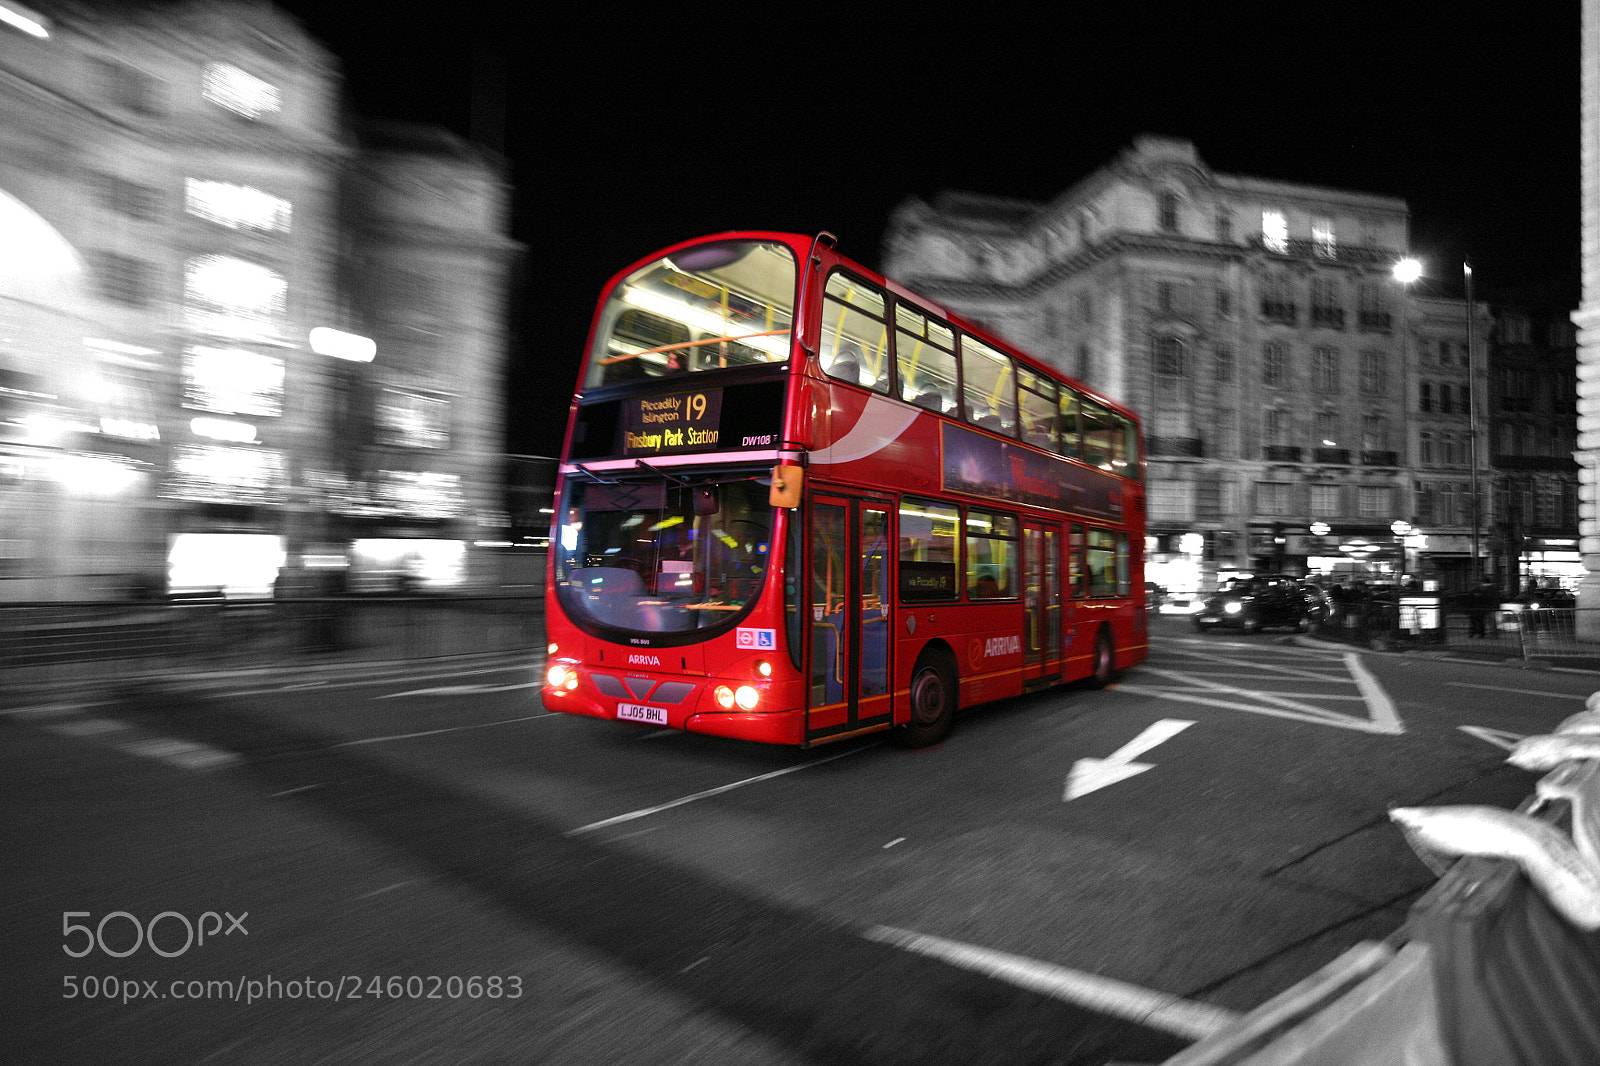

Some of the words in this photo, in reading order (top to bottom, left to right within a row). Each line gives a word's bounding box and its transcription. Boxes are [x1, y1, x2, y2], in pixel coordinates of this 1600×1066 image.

[641, 397, 682, 411] Piccadilly
[686, 393, 707, 421] 19
[642, 411, 680, 424] Islington
[627, 431, 662, 452] Finsbury
[664, 428, 684, 447] Park
[687, 427, 719, 445] Station
[742, 434, 771, 447] DW108
[983, 635, 1022, 658] ARRIVA
[629, 654, 661, 667] ARRIVA
[620, 705, 644, 719] LJ05
[646, 708, 664, 722] BHL
